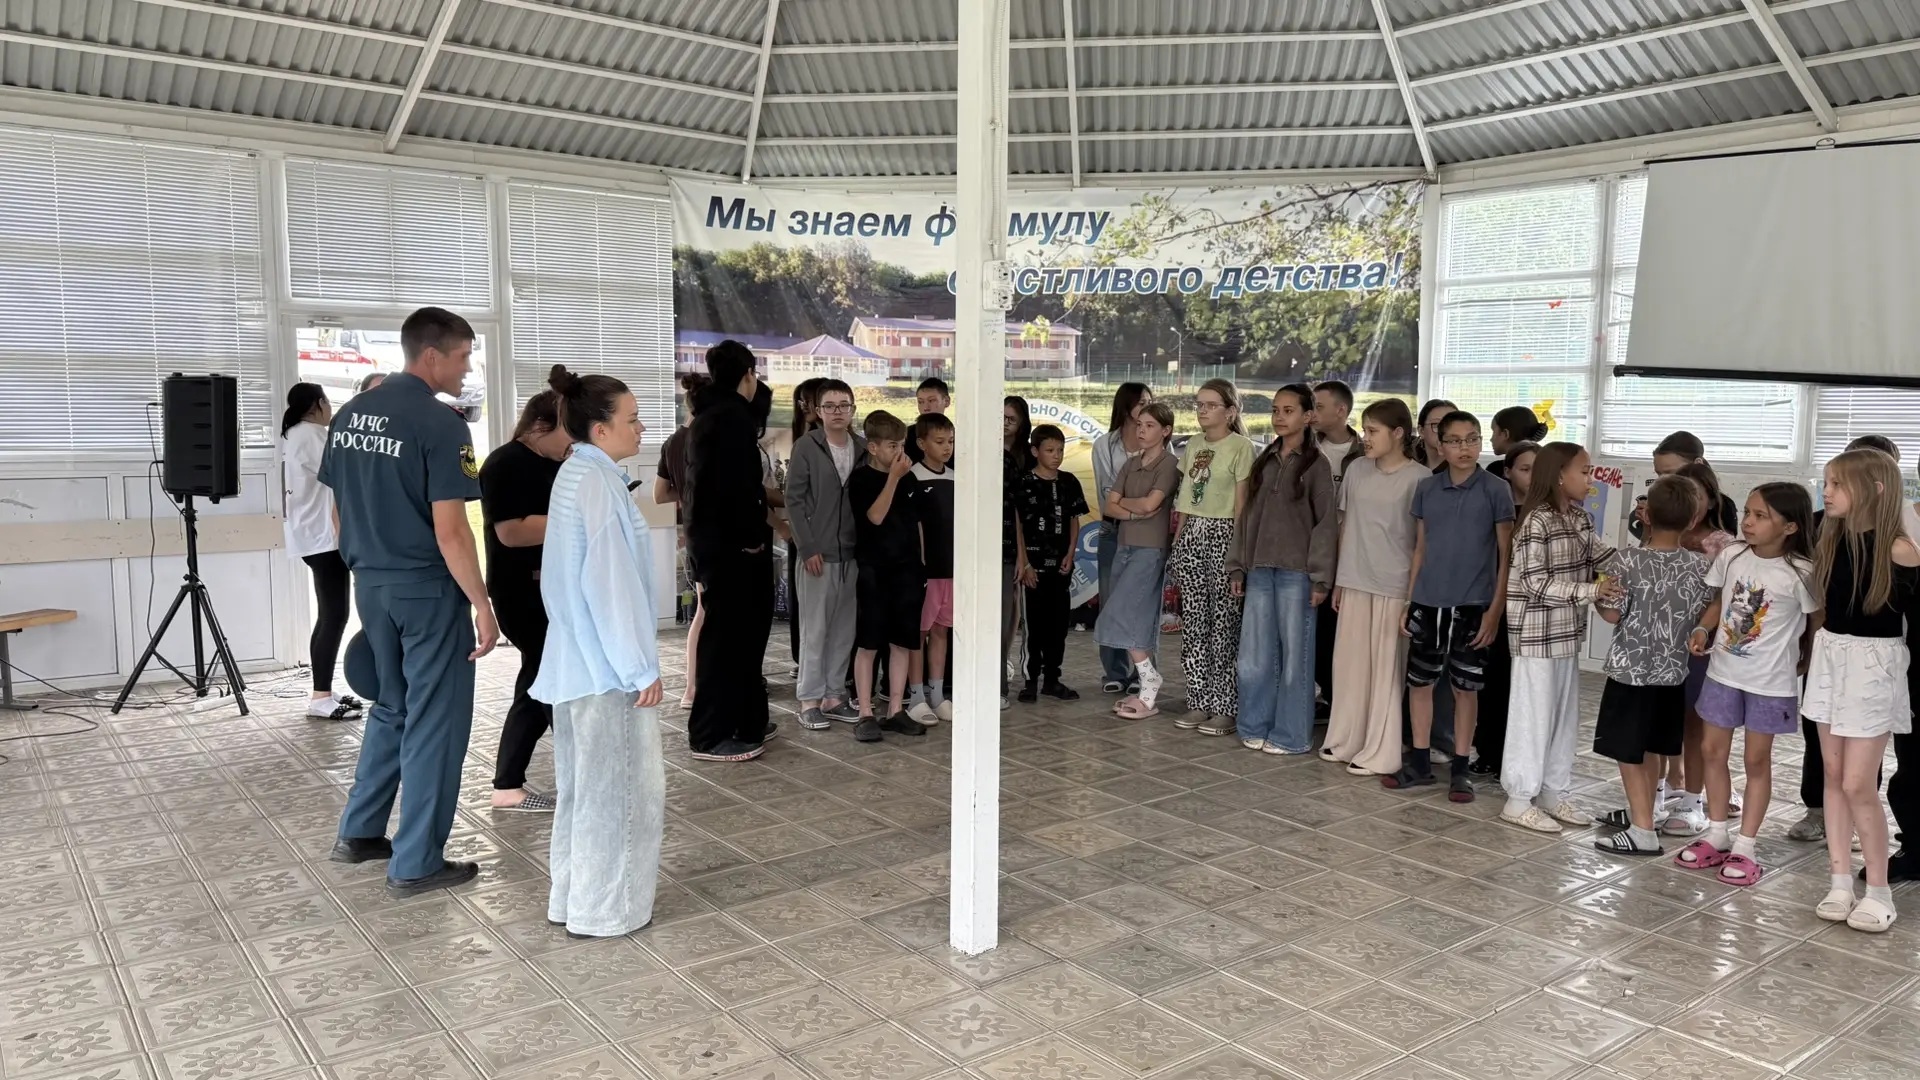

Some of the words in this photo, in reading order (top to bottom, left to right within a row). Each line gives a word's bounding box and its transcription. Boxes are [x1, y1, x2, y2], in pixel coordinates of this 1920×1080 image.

[705, 195, 777, 233] Мы
[787, 209, 912, 238] знаем
[924, 205, 1111, 247] фмулу
[947, 265, 1204, 296] стливого
[1210, 251, 1405, 299] детства!
[347, 412, 390, 433] МЧС
[331, 431, 404, 458] РОССИИ
